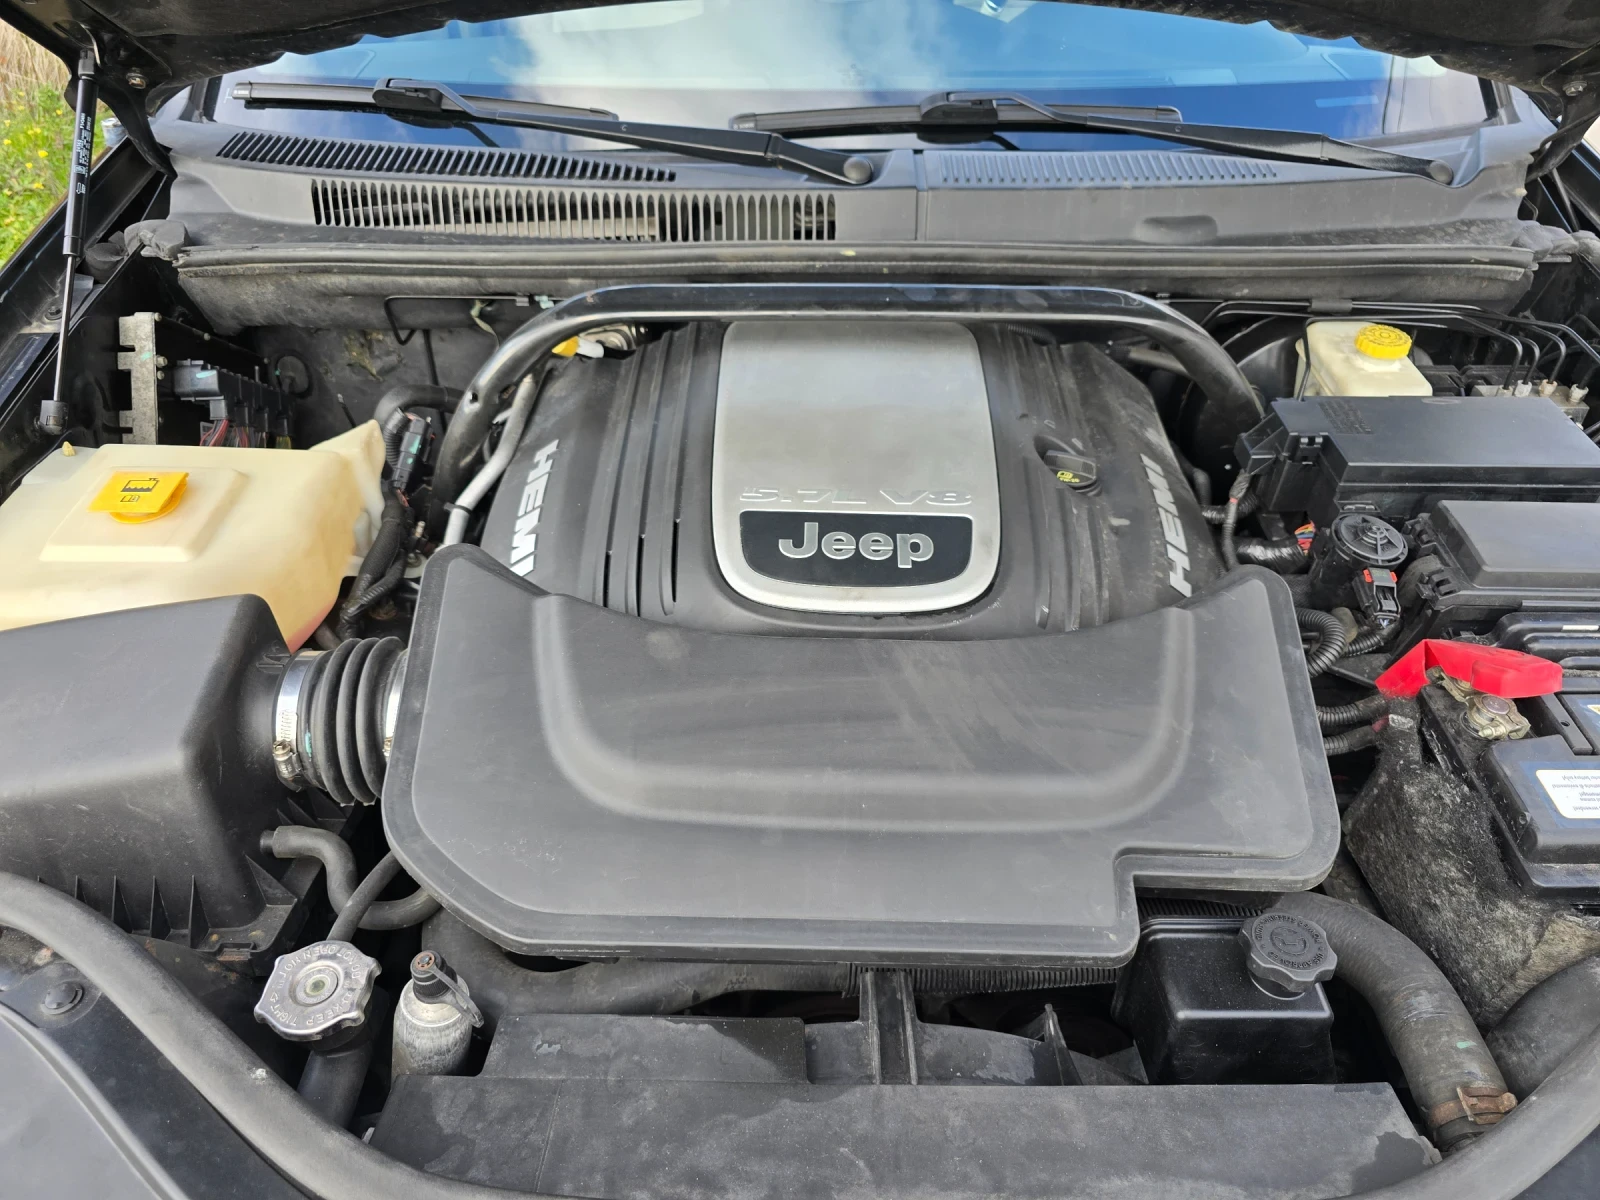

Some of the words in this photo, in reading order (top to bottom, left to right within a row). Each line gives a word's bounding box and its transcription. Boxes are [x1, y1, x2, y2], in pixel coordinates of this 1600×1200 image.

[510, 439, 559, 577] HEMI
[739, 487, 867, 505] 5.7L
[879, 489, 972, 506] V8
[1140, 453, 1192, 598] HEMI
[778, 521, 934, 568] Jeep
[303, 945, 338, 960] OPEN
[337, 948, 358, 965] NOT
[351, 963, 362, 979] DO
[270, 1004, 299, 1027] TIGHT
[306, 1003, 343, 1026] KEEP
